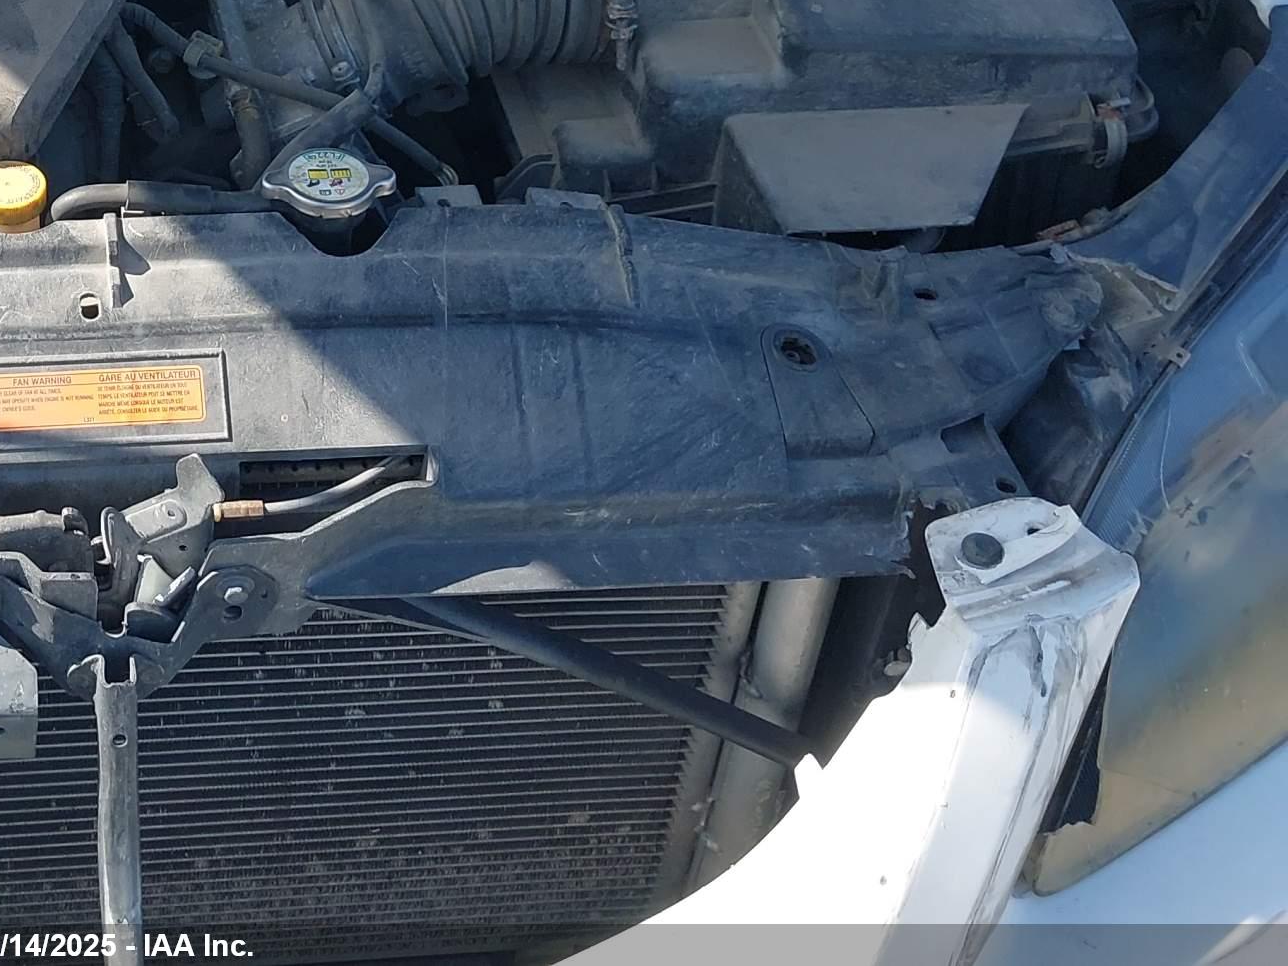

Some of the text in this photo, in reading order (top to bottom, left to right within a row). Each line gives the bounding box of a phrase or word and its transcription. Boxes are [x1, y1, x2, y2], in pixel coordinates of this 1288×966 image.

[13, 377, 71, 386] FAN WARNING
[99, 374, 121, 382] GARE
[137, 371, 195, 380] VENTILATEUR
